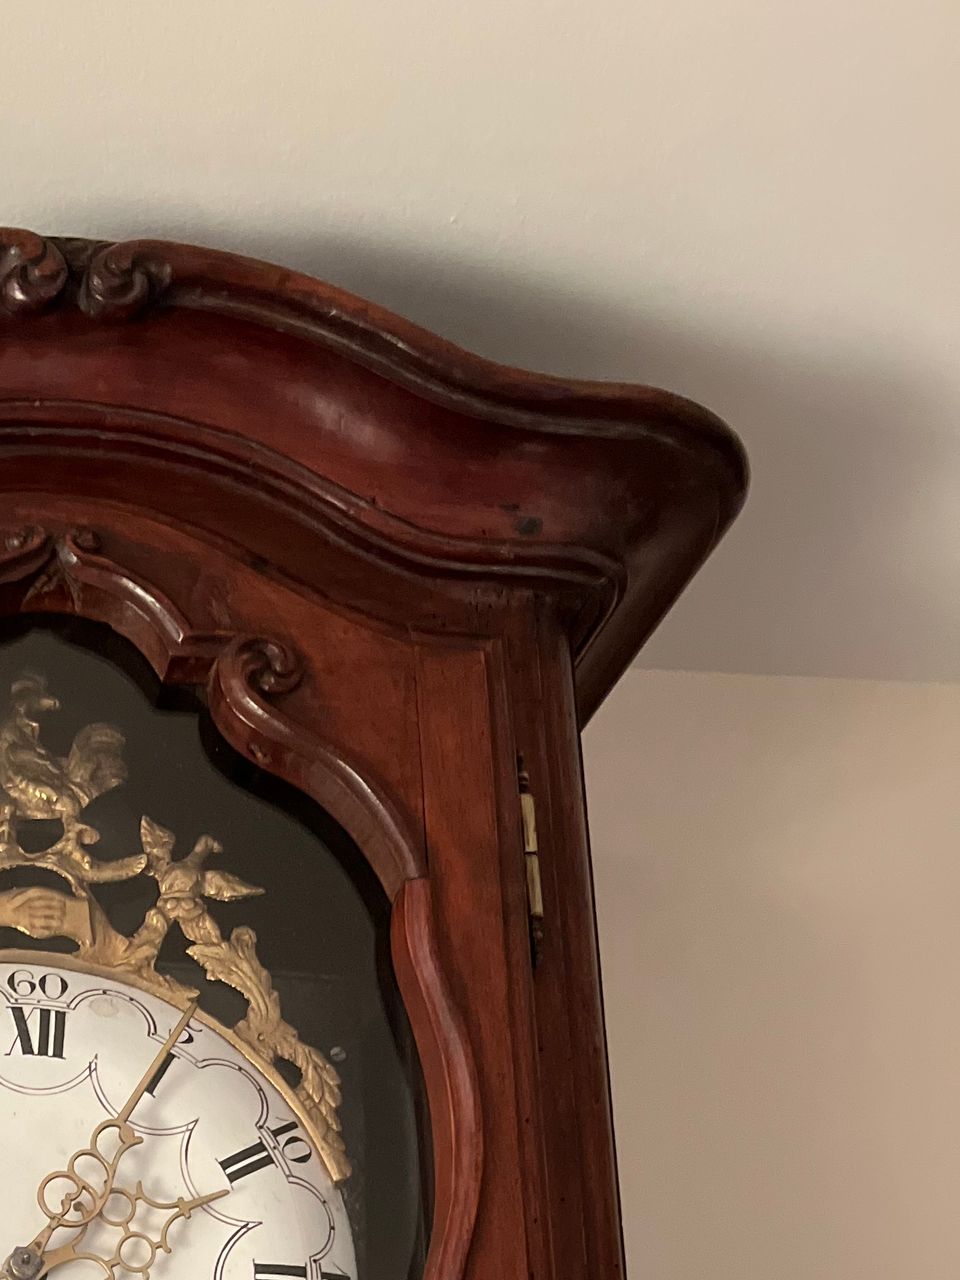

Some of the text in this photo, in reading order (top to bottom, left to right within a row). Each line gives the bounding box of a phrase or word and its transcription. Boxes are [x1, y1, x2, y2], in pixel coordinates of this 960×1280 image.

[7, 970, 69, 999] 60
[4, 1006, 74, 1059] XII
[215, 1136, 279, 1190] II
[275, 1115, 312, 1164] 10
